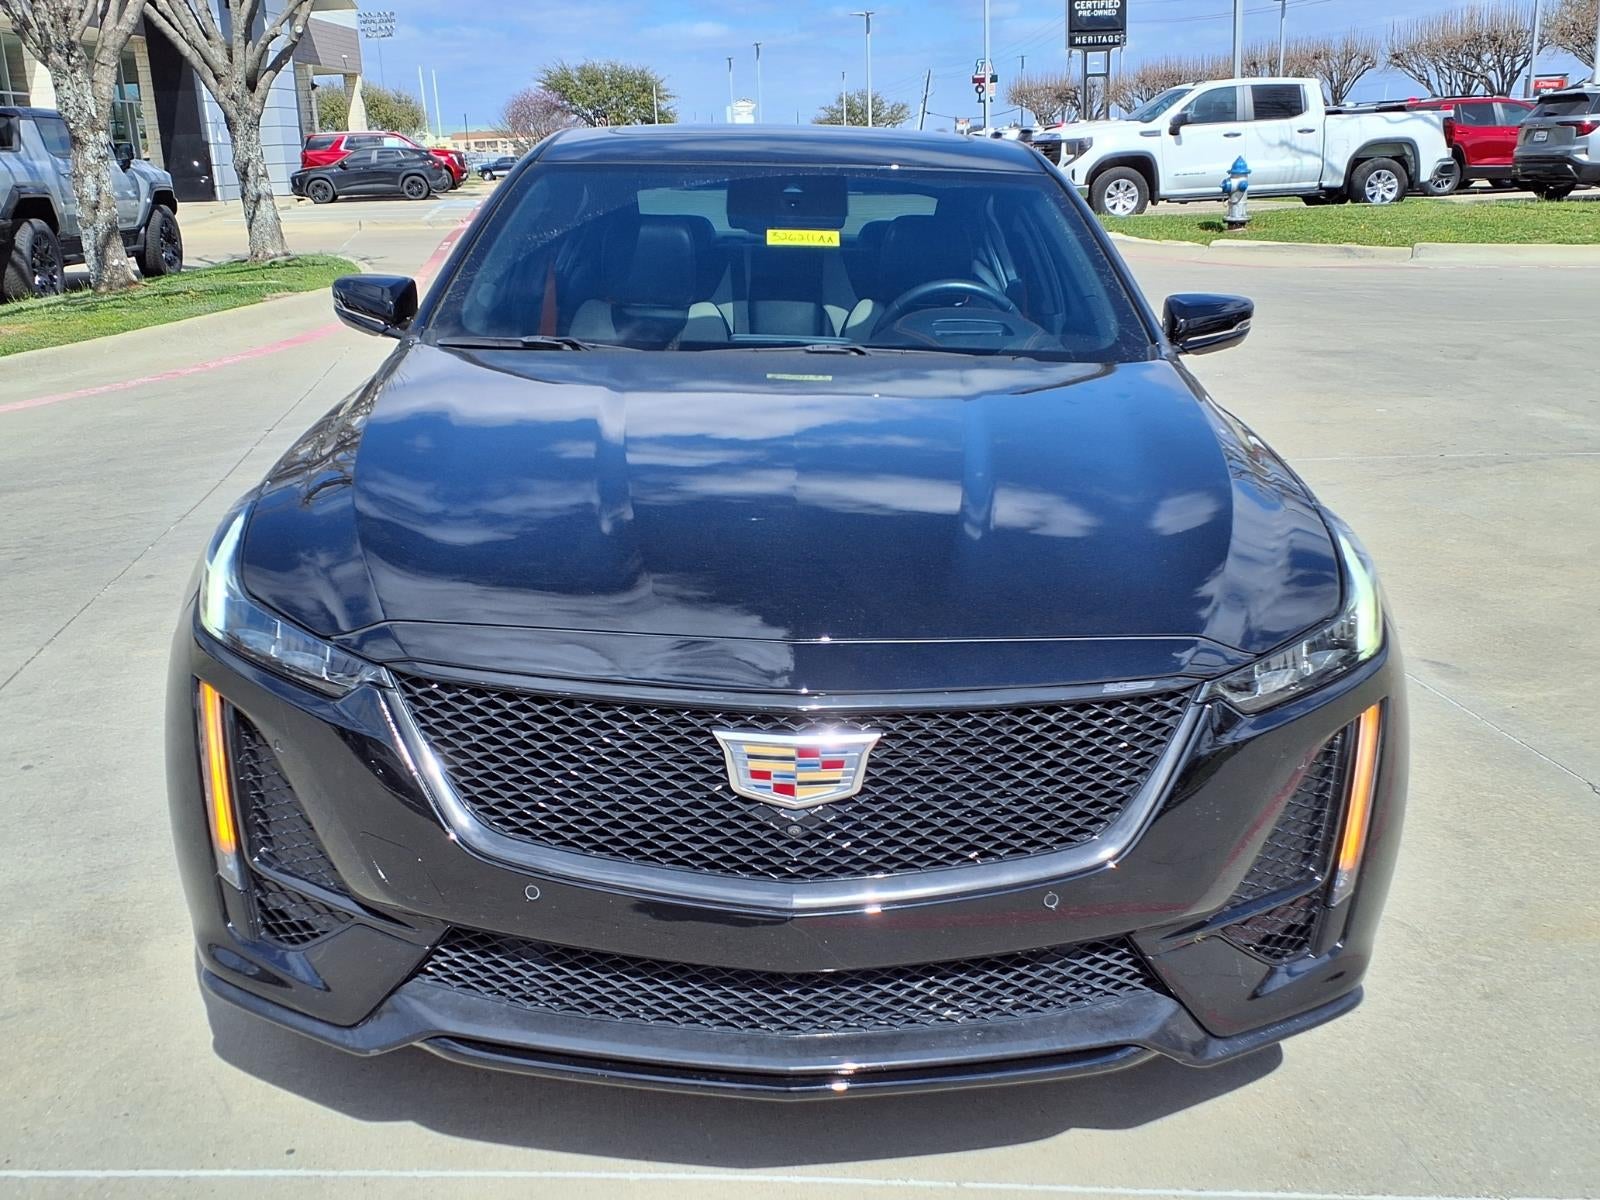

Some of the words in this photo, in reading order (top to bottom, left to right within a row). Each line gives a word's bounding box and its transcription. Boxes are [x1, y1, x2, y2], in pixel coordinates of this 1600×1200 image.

[1074, 0, 1121, 9] CERTIFIED
[1077, 9, 1117, 17] PRE-OWNED
[1075, 35, 1120, 44] HERITAGE
